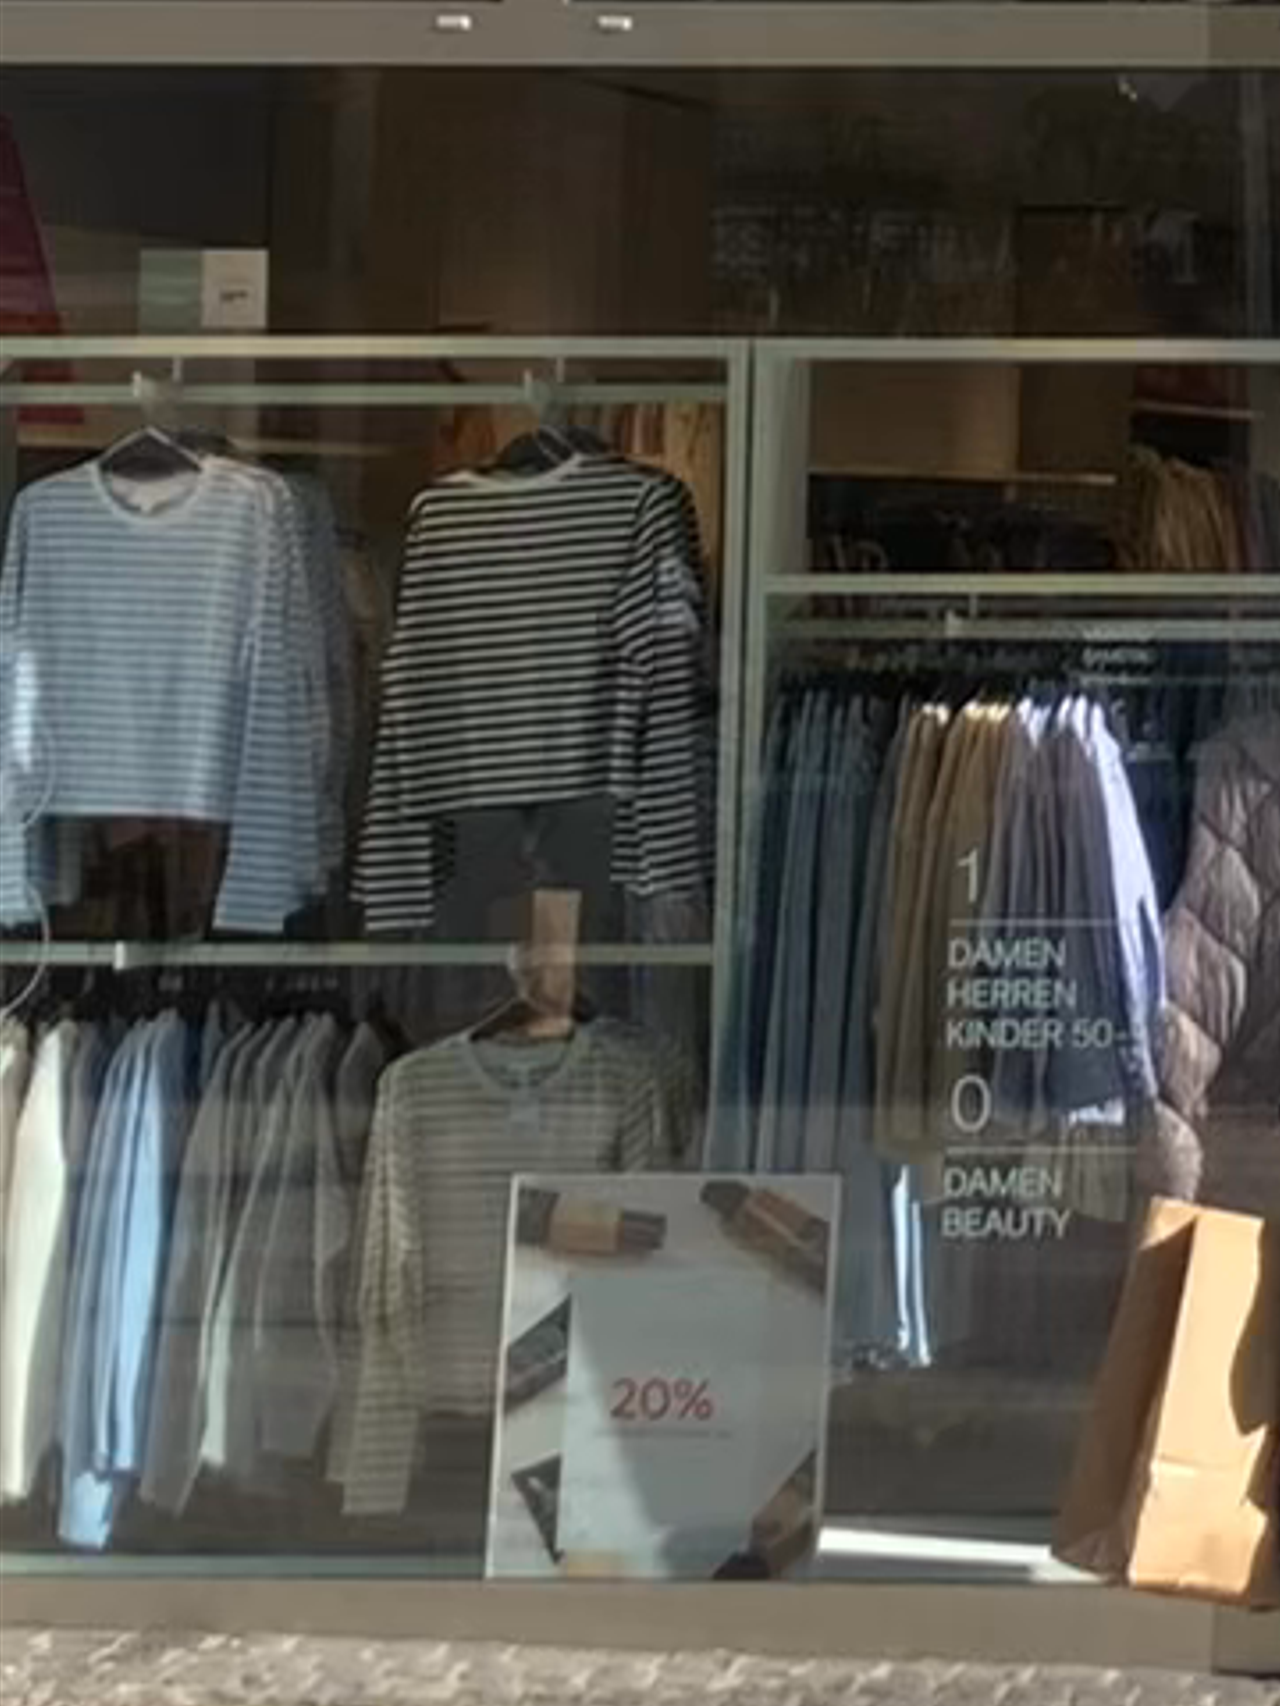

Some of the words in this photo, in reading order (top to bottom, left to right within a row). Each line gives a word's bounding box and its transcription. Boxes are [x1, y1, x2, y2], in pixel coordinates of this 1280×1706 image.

[956, 849, 978, 903] 1
[947, 937, 1067, 970] DAMEN
[946, 979, 1077, 1010] HERREN
[946, 1018, 1063, 1049] KINDER
[951, 1074, 991, 1133] 0
[943, 1167, 1062, 1198] DAMEN
[941, 1207, 1072, 1240] BEAUTY
[609, 1377, 715, 1422] 20%
